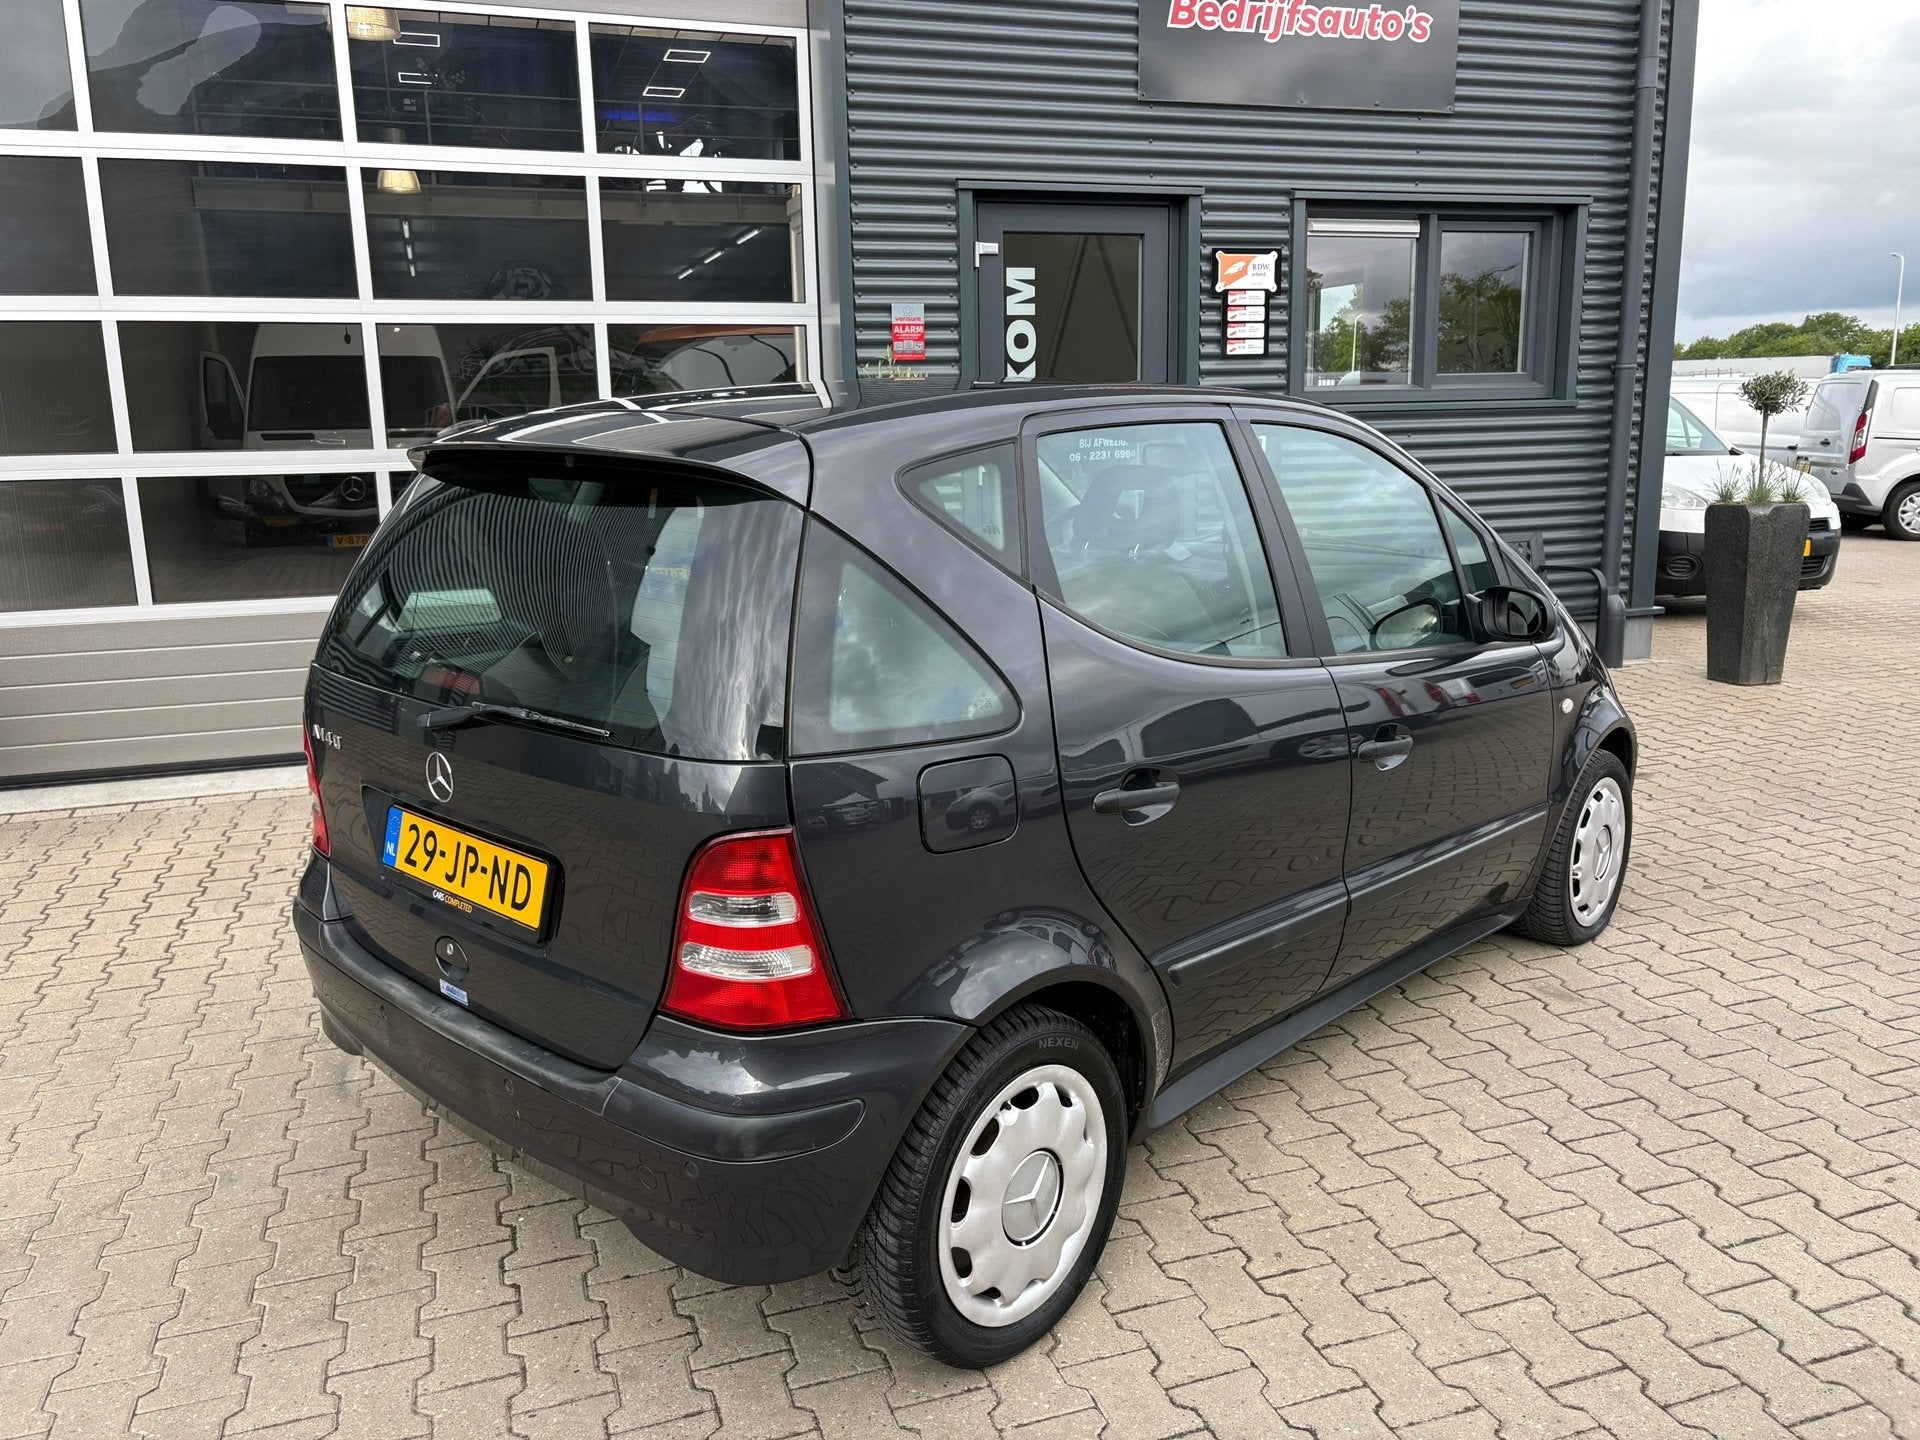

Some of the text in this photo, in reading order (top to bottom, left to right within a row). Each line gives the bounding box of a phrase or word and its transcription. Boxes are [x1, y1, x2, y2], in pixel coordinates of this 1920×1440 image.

[1167, 0, 1433, 43] Bedrijfsauto's
[894, 325, 923, 334] ALARM
[1079, 438, 1092, 449] BIJ
[1089, 450, 1111, 461] 2231
[386, 841, 396, 857] NL
[404, 823, 532, 911] 29-JP-ND
[1038, 1037, 1080, 1050] NEXEN
